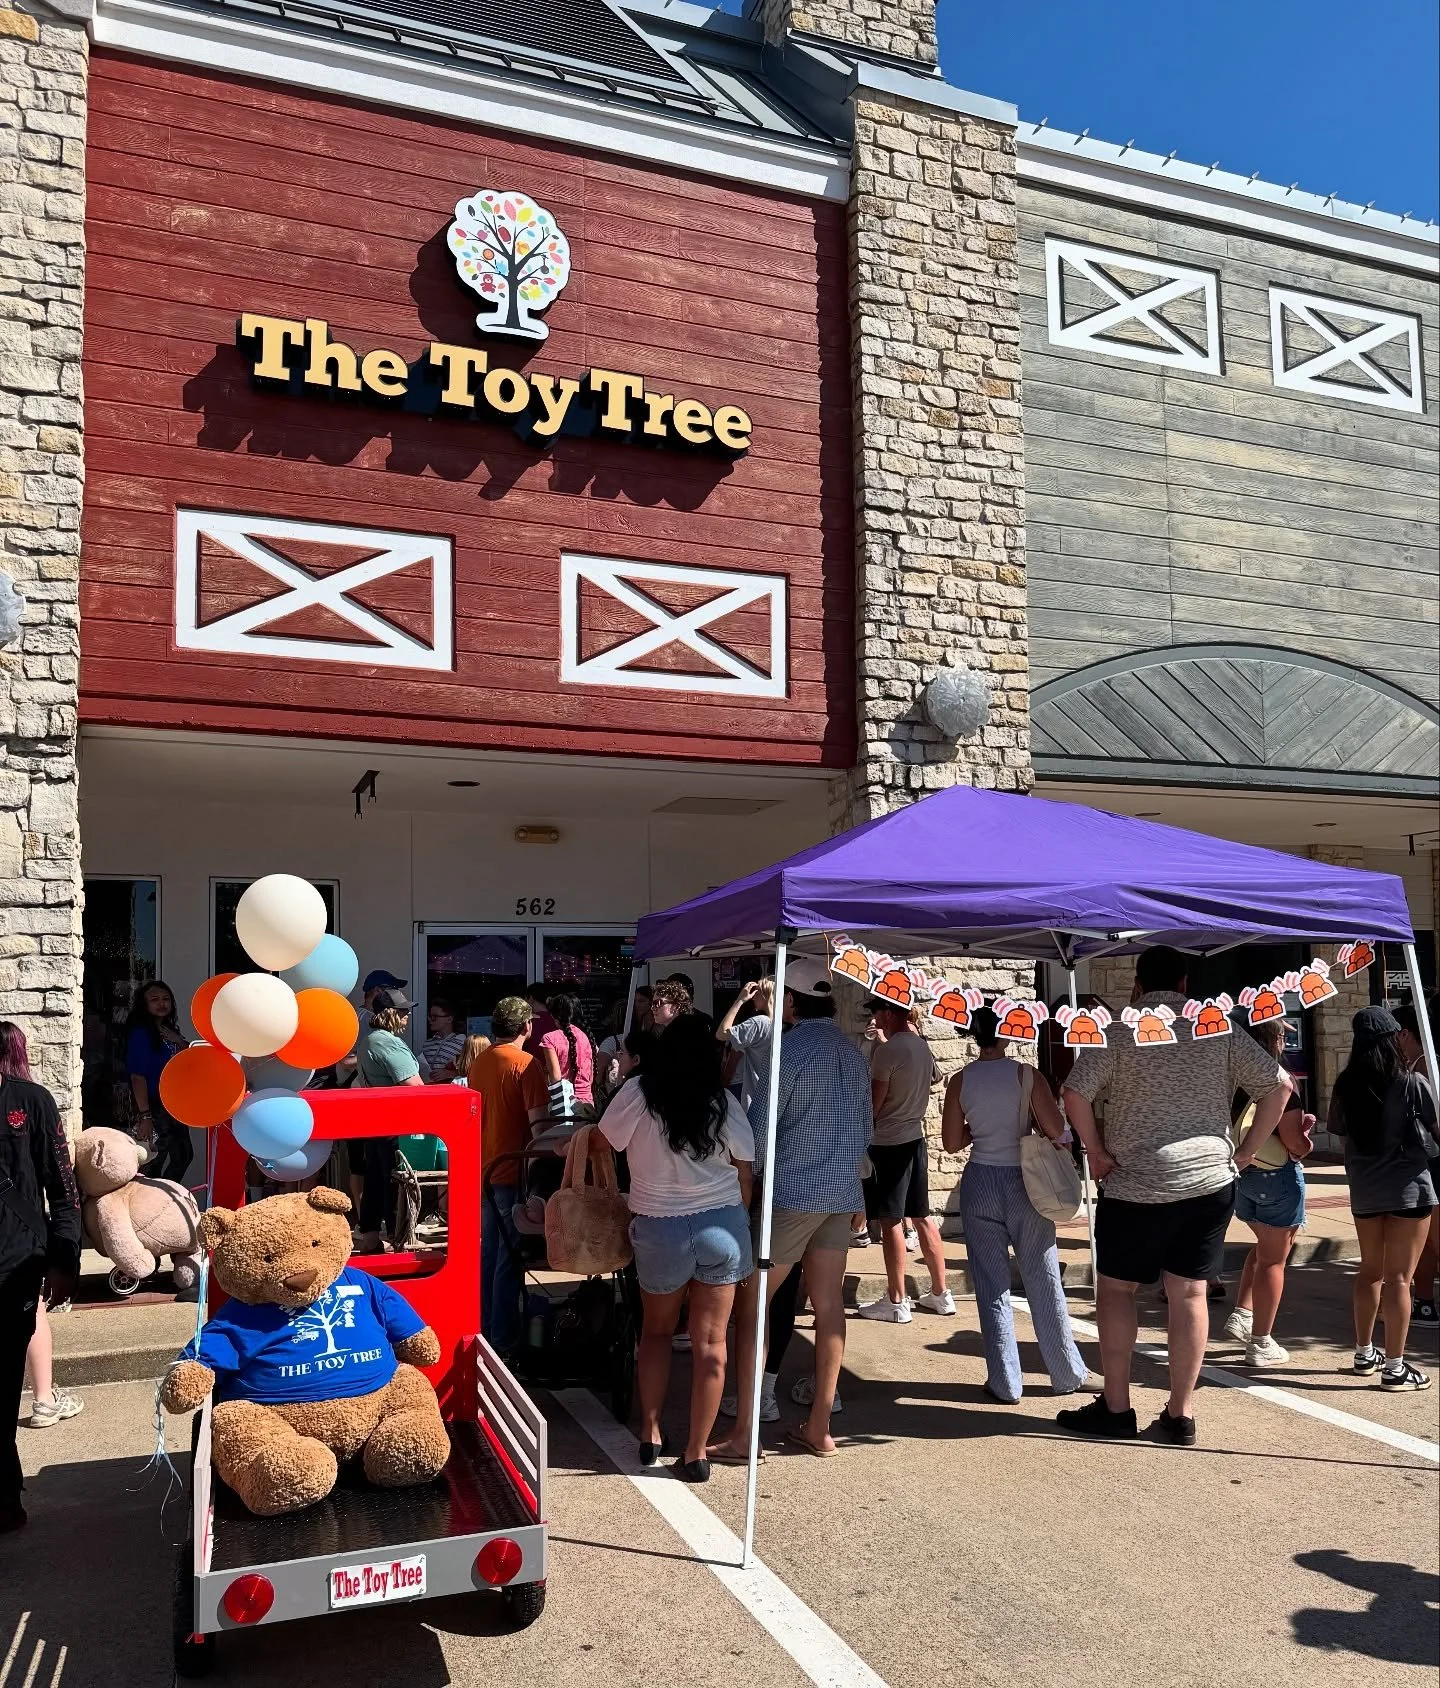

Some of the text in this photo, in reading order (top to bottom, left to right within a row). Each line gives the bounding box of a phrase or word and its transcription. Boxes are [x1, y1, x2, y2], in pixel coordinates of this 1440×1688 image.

[241, 312, 754, 450] The Toy Tree
[515, 897, 556, 916] 562
[278, 1347, 383, 1378] THE TOY TREE
[334, 1561, 423, 1599] The Toy Tree
